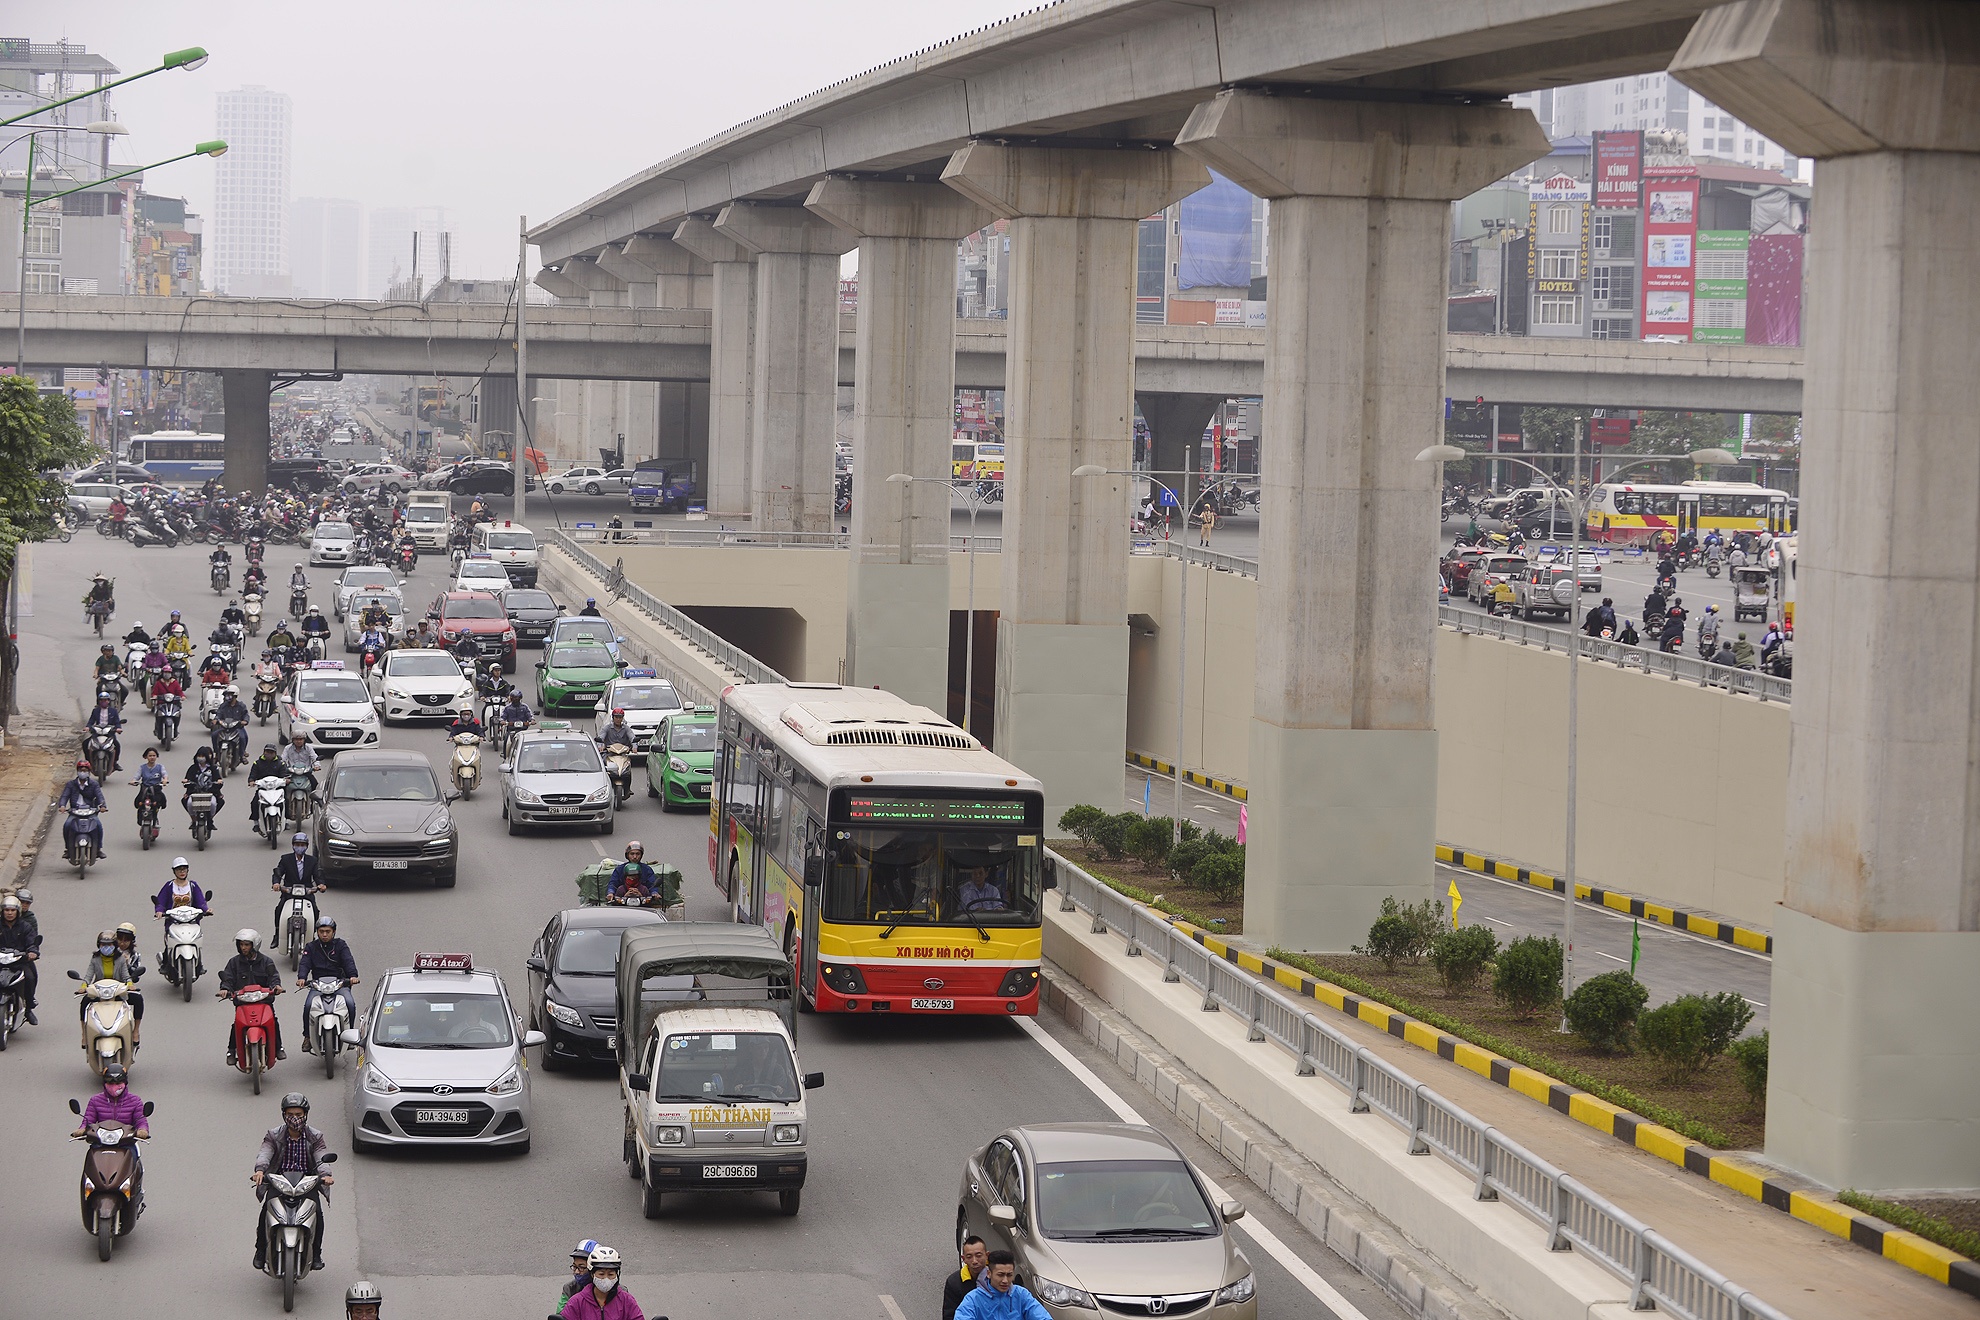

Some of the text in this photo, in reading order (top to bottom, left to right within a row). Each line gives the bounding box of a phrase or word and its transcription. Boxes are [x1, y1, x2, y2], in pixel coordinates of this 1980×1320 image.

[1607, 163, 1629, 176] KÍNH
[1545, 177, 1576, 190] HOTEL
[1597, 177, 1638, 193] HẢI LONG
[1531, 190, 1588, 200] HOÀNG LONG
[1527, 244, 1536, 274] LONG
[1539, 281, 1575, 292] HOTEL
[914, 947, 934, 958] BUS
[936, 946, 951, 958] HÀ
[953, 946, 974, 961] NỘI
[913, 1000, 952, 1009] 30Z-5793
[418, 1111, 467, 1122] 30A-394.89
[689, 1105, 772, 1123] TIẾN THÀNH
[704, 1166, 756, 1178] 29C-096.66
